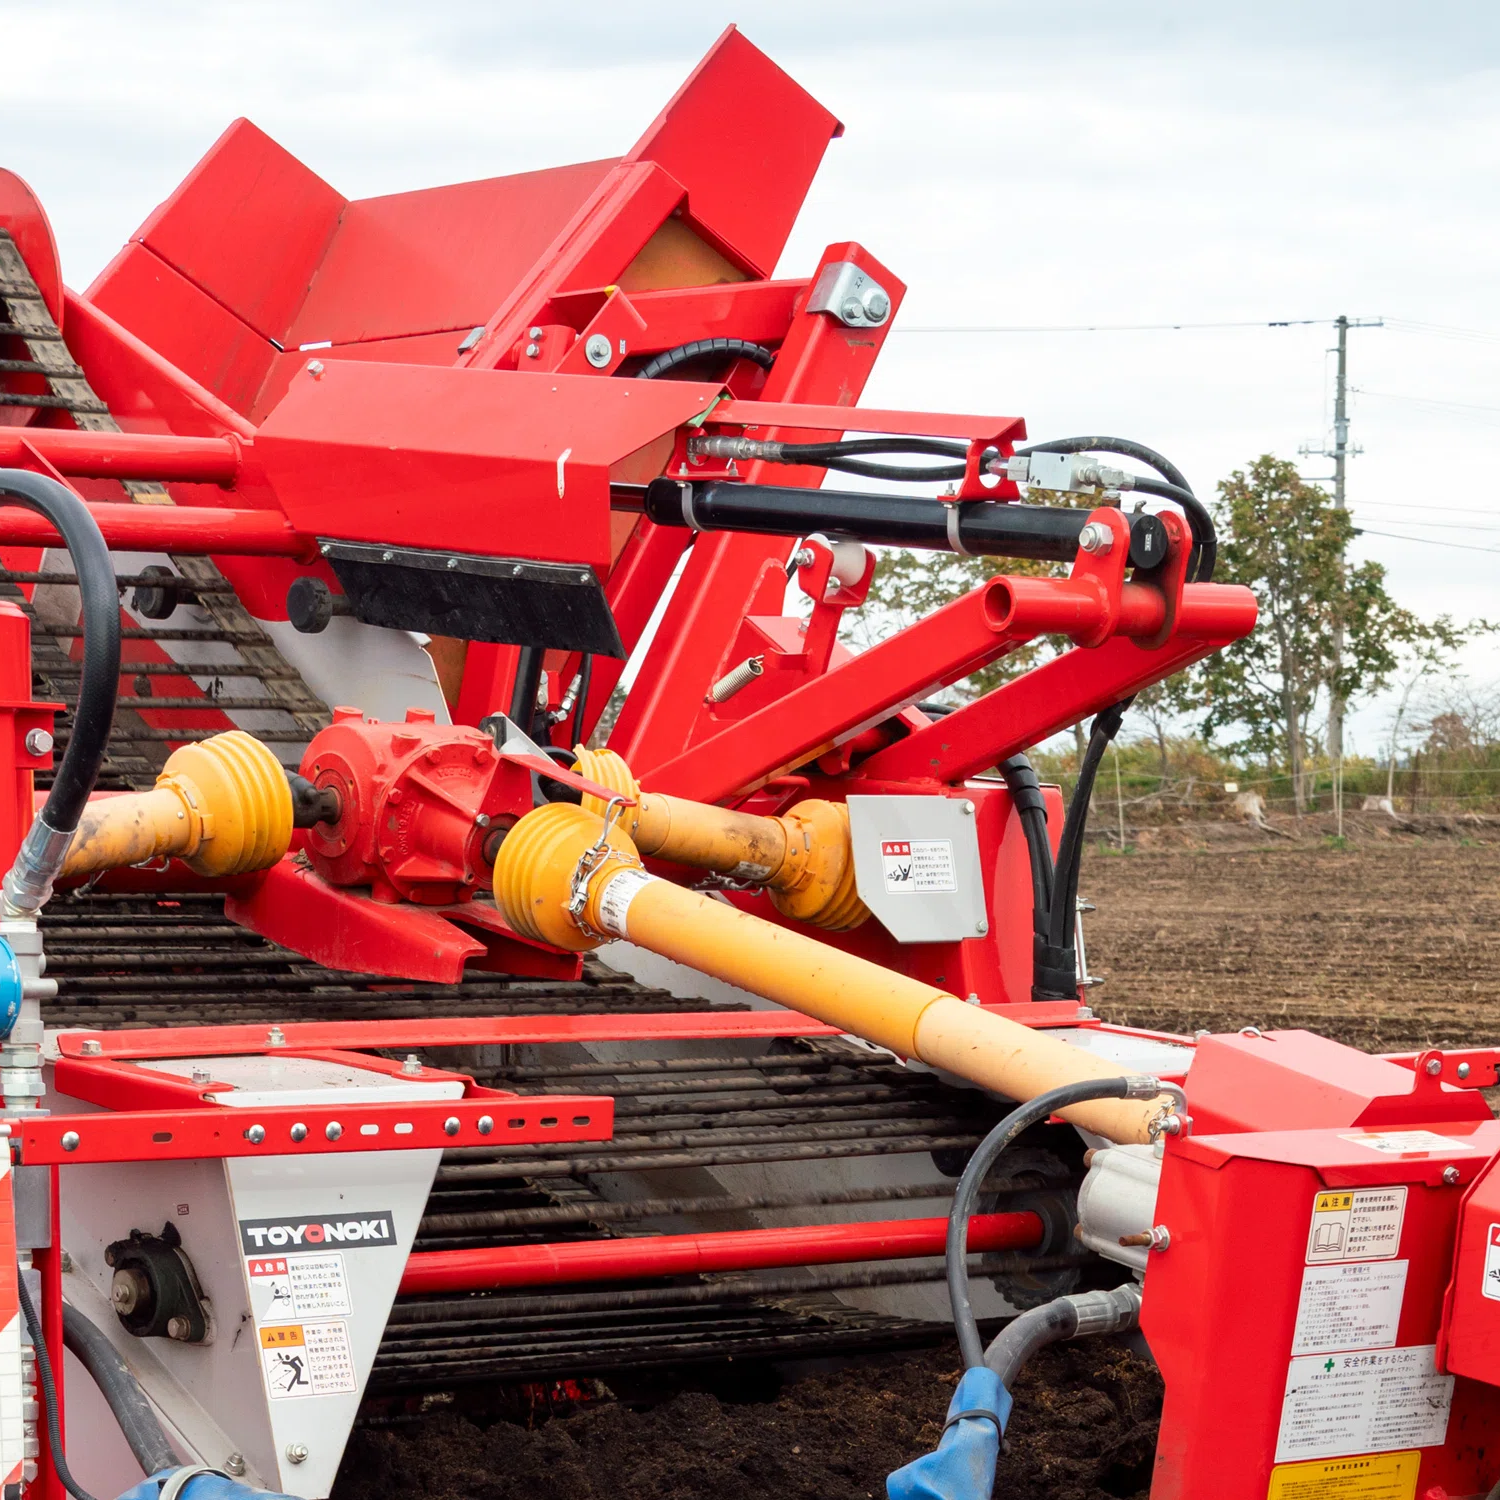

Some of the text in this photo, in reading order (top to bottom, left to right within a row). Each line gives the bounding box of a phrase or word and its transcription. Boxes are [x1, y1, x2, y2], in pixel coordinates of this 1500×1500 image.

[1331, 1197, 1350, 1207] 注意
[247, 1219, 390, 1246] TOYONOKI
[265, 1261, 287, 1273] 危険
[277, 1331, 298, 1341] 警告
[1343, 1353, 1417, 1369] 安全作業をするために
